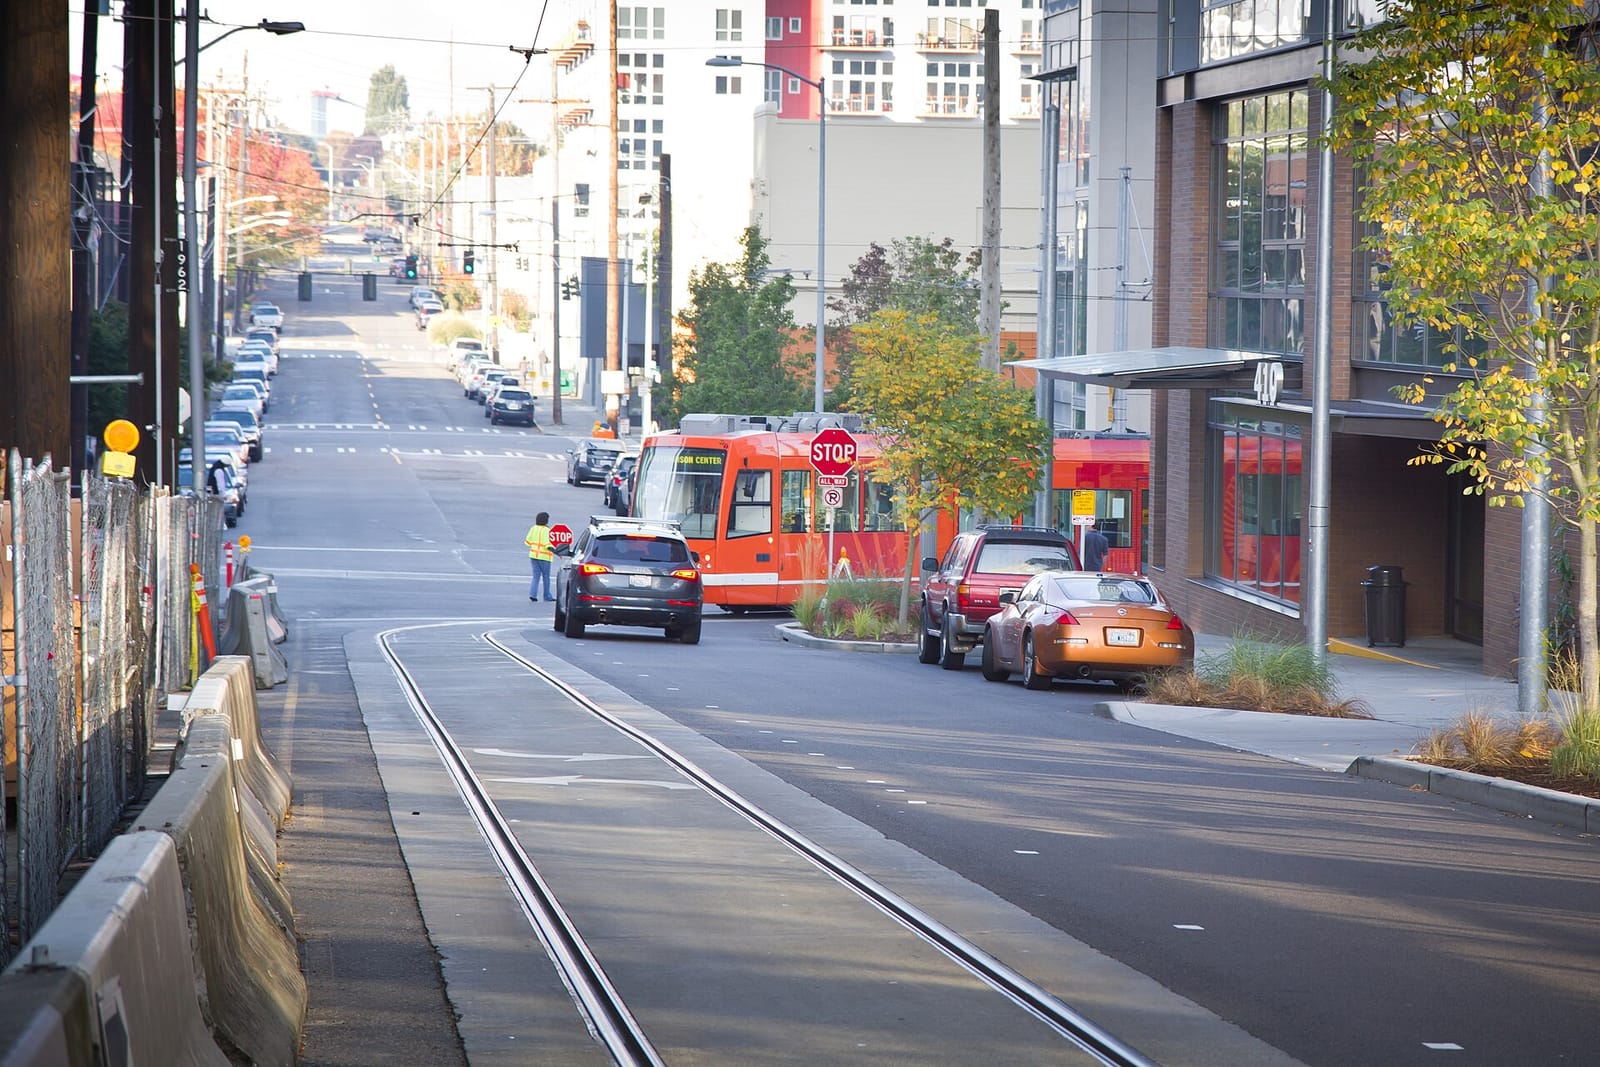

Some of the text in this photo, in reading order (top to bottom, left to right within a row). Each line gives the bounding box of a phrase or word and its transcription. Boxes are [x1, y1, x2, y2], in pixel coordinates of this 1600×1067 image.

[177, 240, 187, 290] 1962
[1253, 362, 1284, 402] 410
[678, 455, 722, 465] SON CENTER
[812, 443, 855, 462] STOP
[549, 531, 572, 543] STOP
